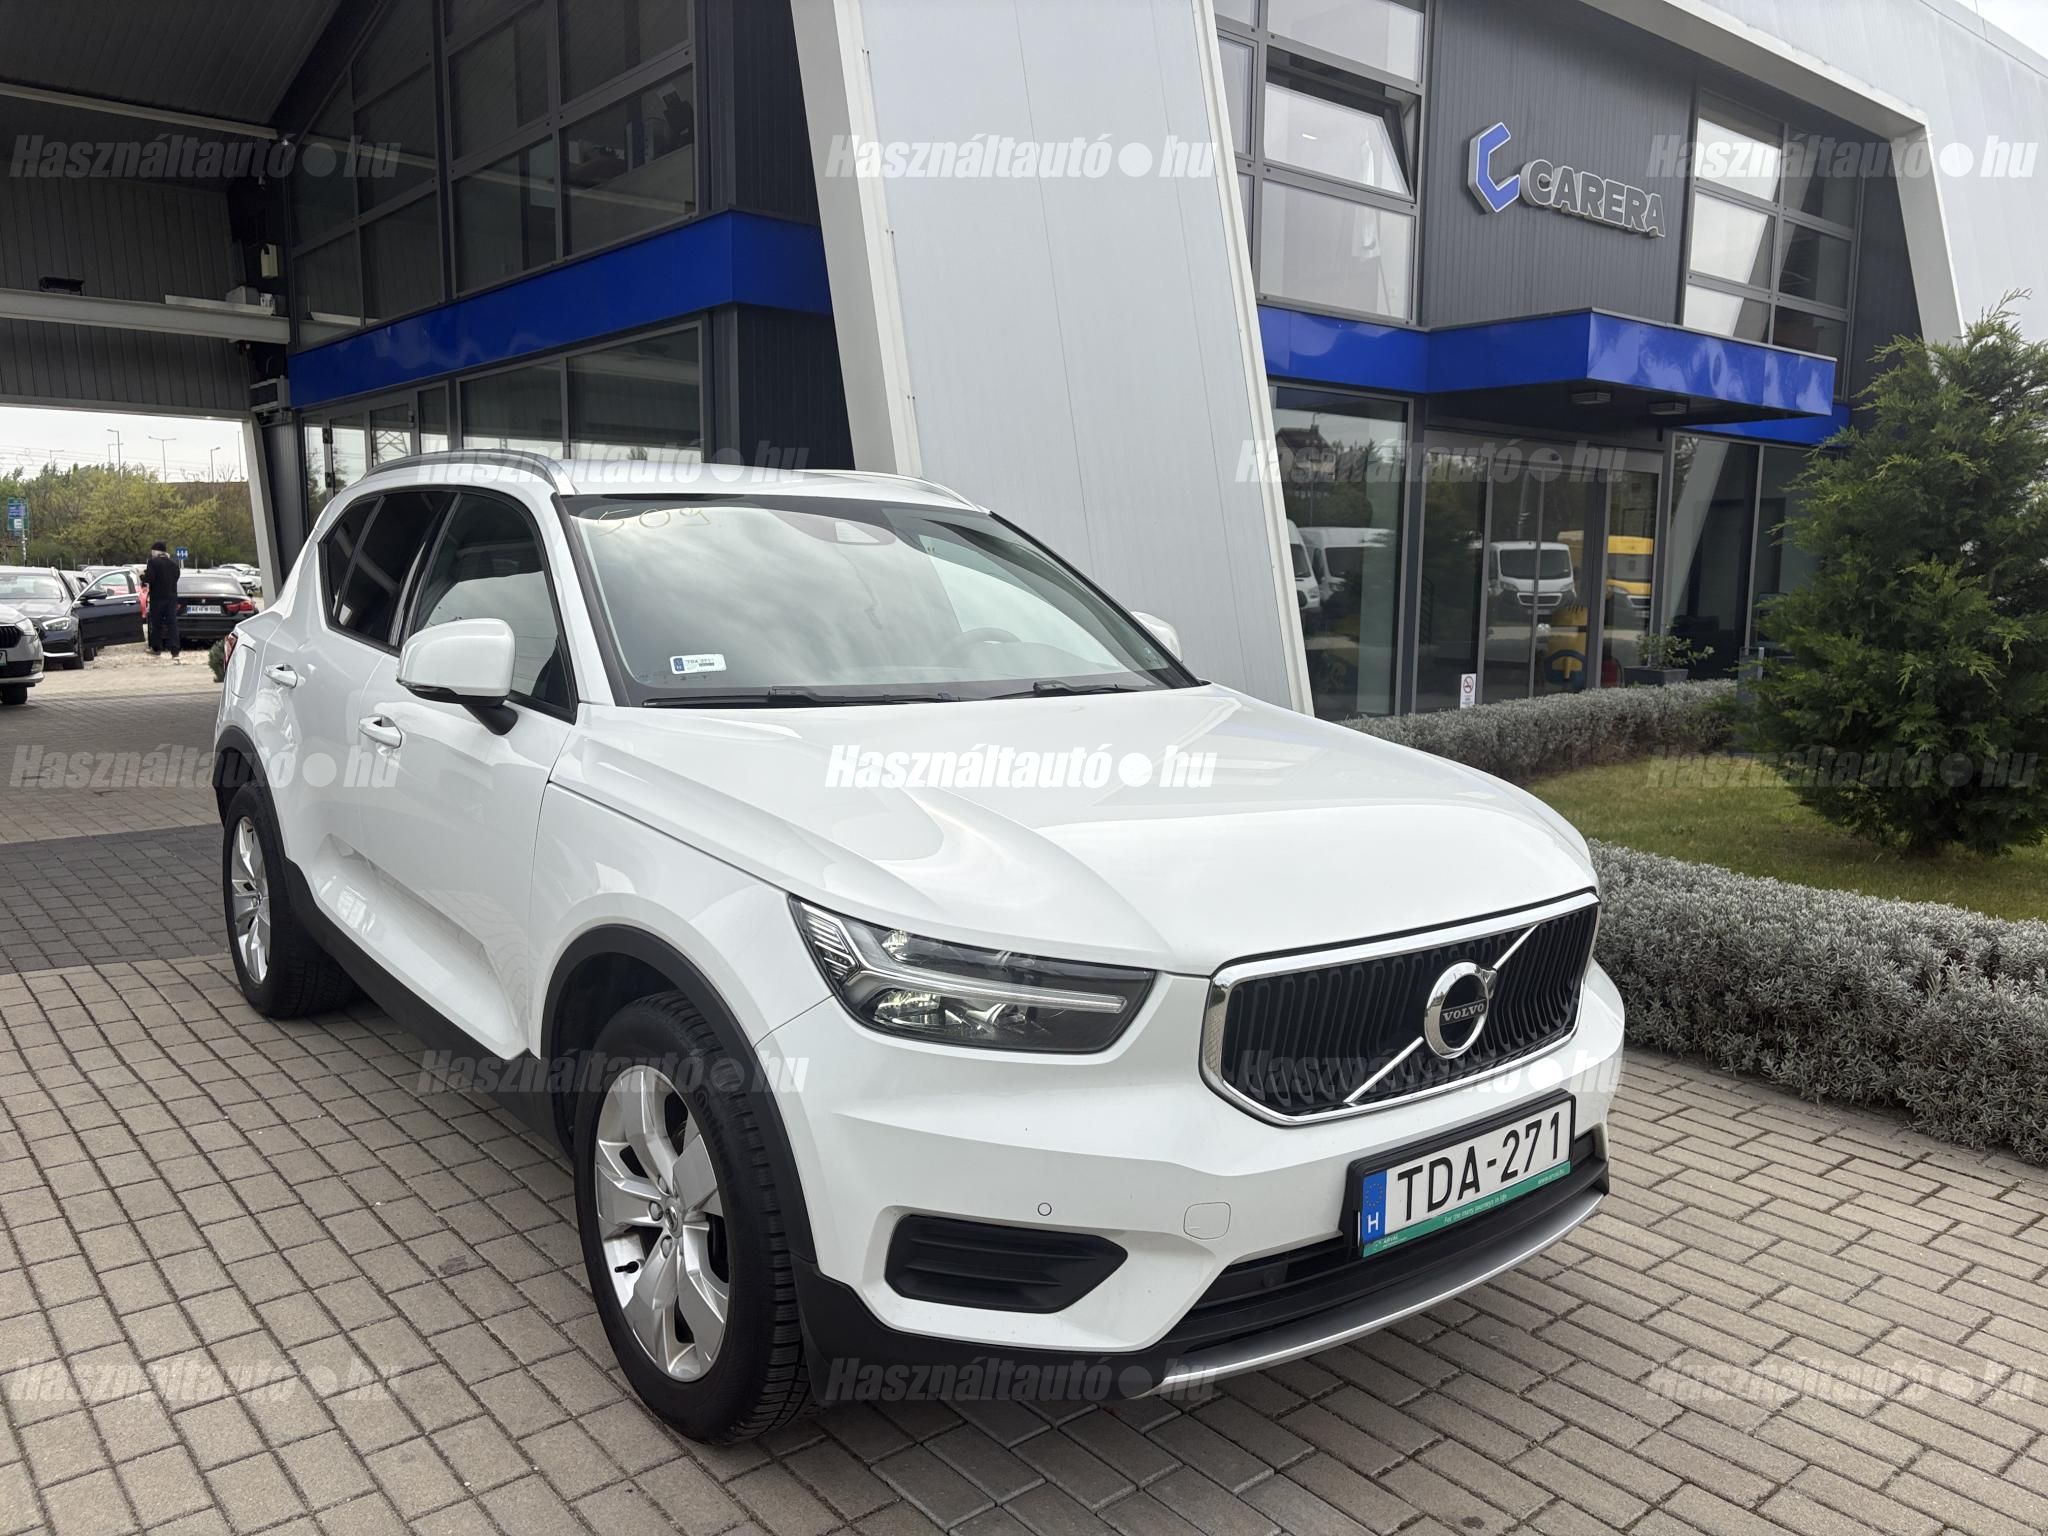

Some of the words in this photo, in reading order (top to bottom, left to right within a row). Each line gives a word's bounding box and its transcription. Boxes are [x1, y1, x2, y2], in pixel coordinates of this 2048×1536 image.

[1521, 158, 1666, 238] CARERA
[1443, 1003, 1485, 1022] VOLVO
[1398, 1112, 1560, 1222] TDA-271
[1367, 1211, 1379, 1234] H
